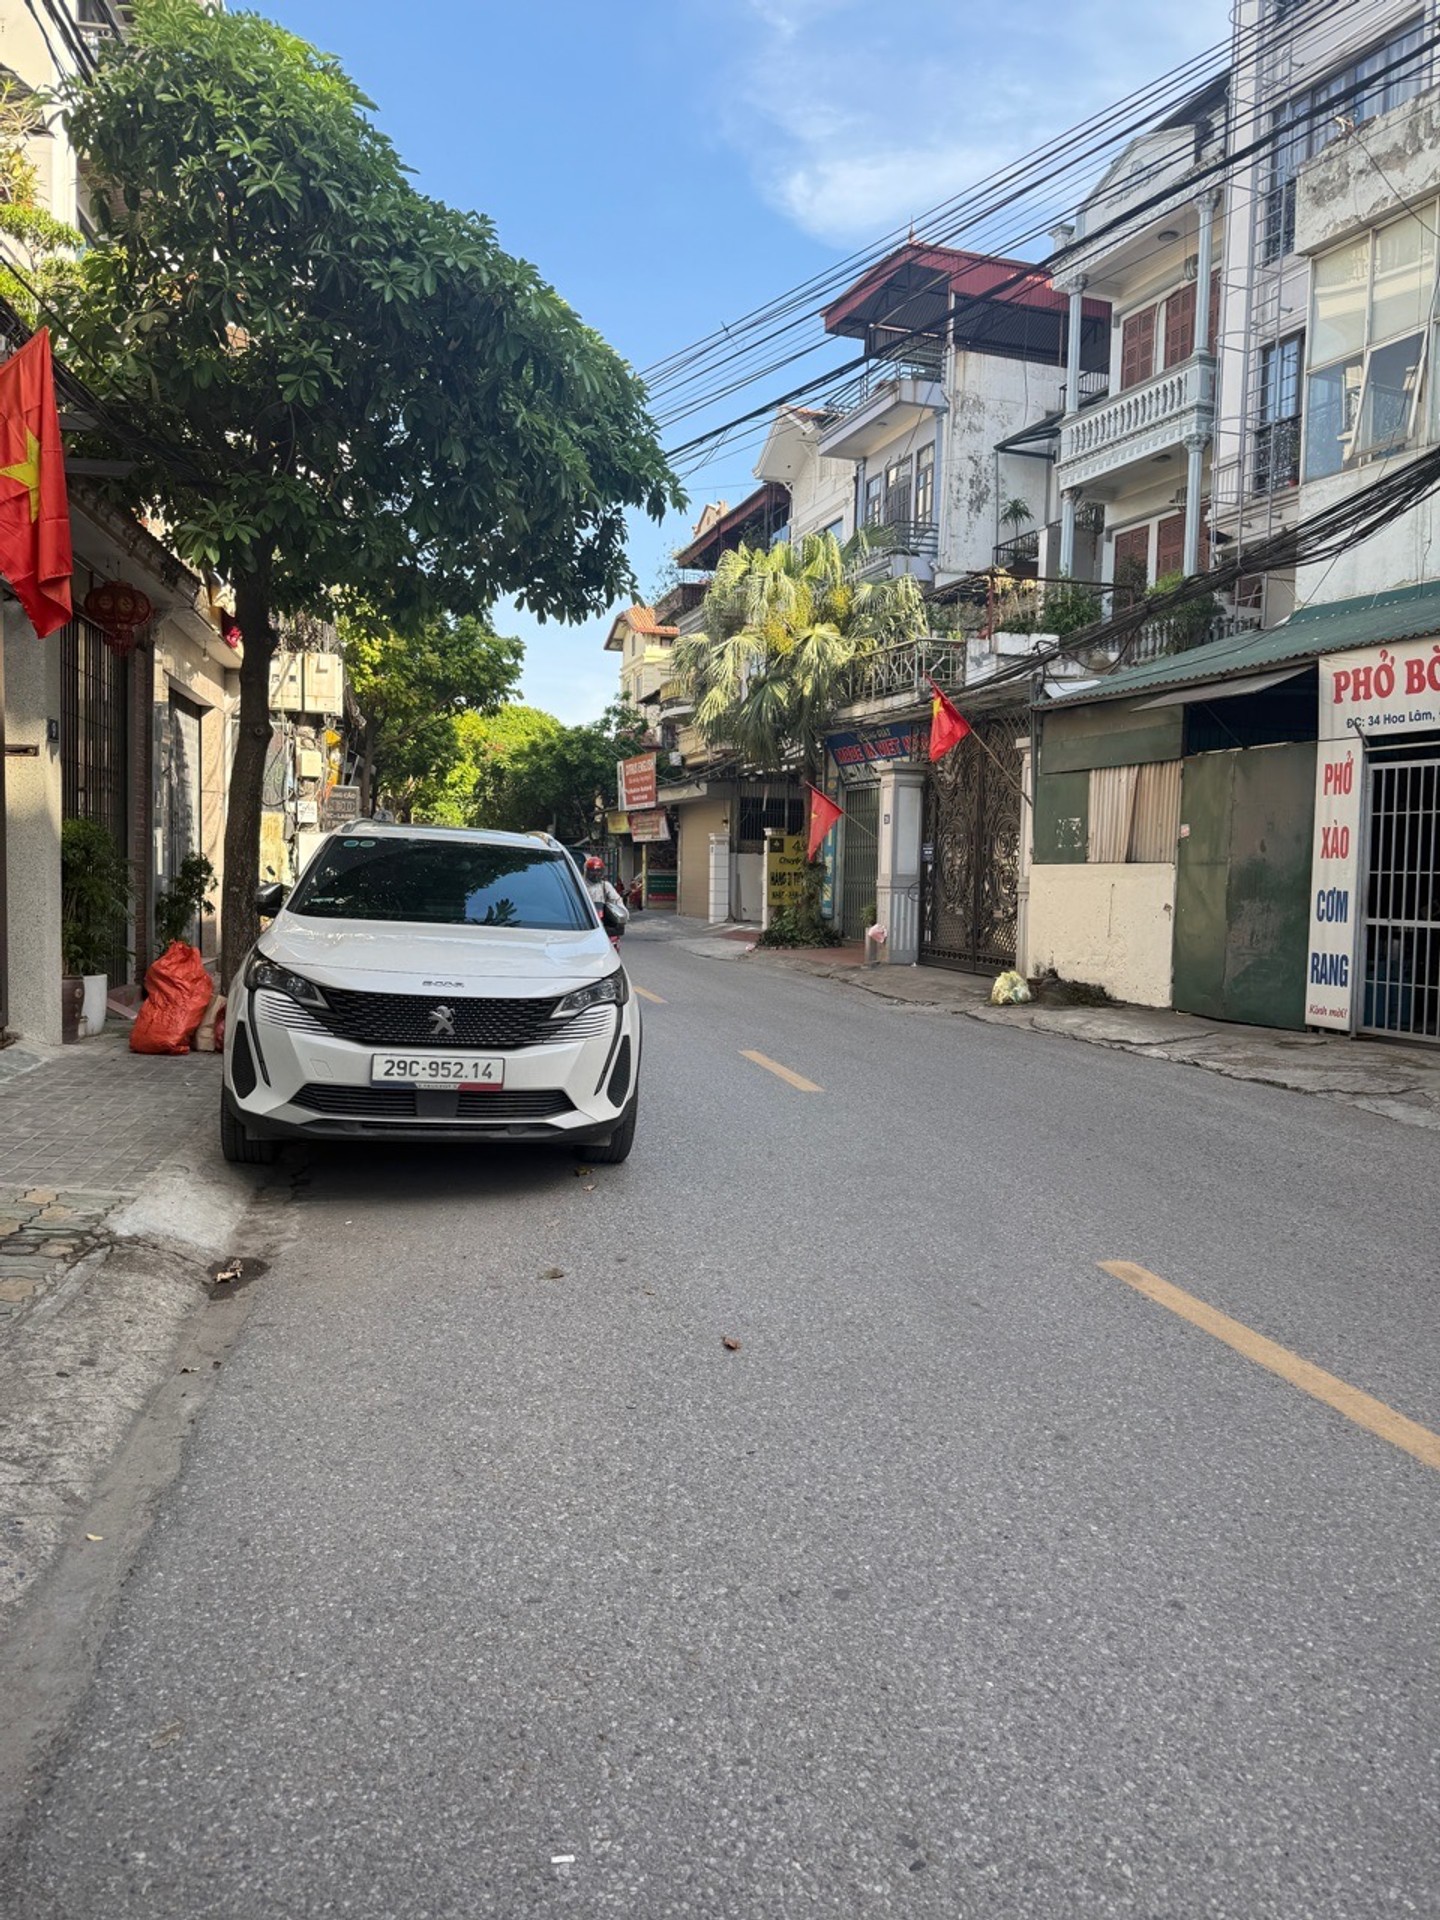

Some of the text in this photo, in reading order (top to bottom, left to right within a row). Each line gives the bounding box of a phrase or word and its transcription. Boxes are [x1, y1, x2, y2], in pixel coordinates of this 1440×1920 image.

[1333, 649, 1395, 704] PHỞ
[1368, 715, 1380, 726] 34
[1383, 714, 1405, 725] Hoa
[1408, 709, 1436, 722] Lâm,
[1323, 750, 1354, 795] PHỞ
[1320, 820, 1350, 859] XÀO
[1316, 887, 1348, 923] CƠM
[1311, 952, 1349, 988] RANG
[383, 1060, 493, 1079] 29C-952.14
